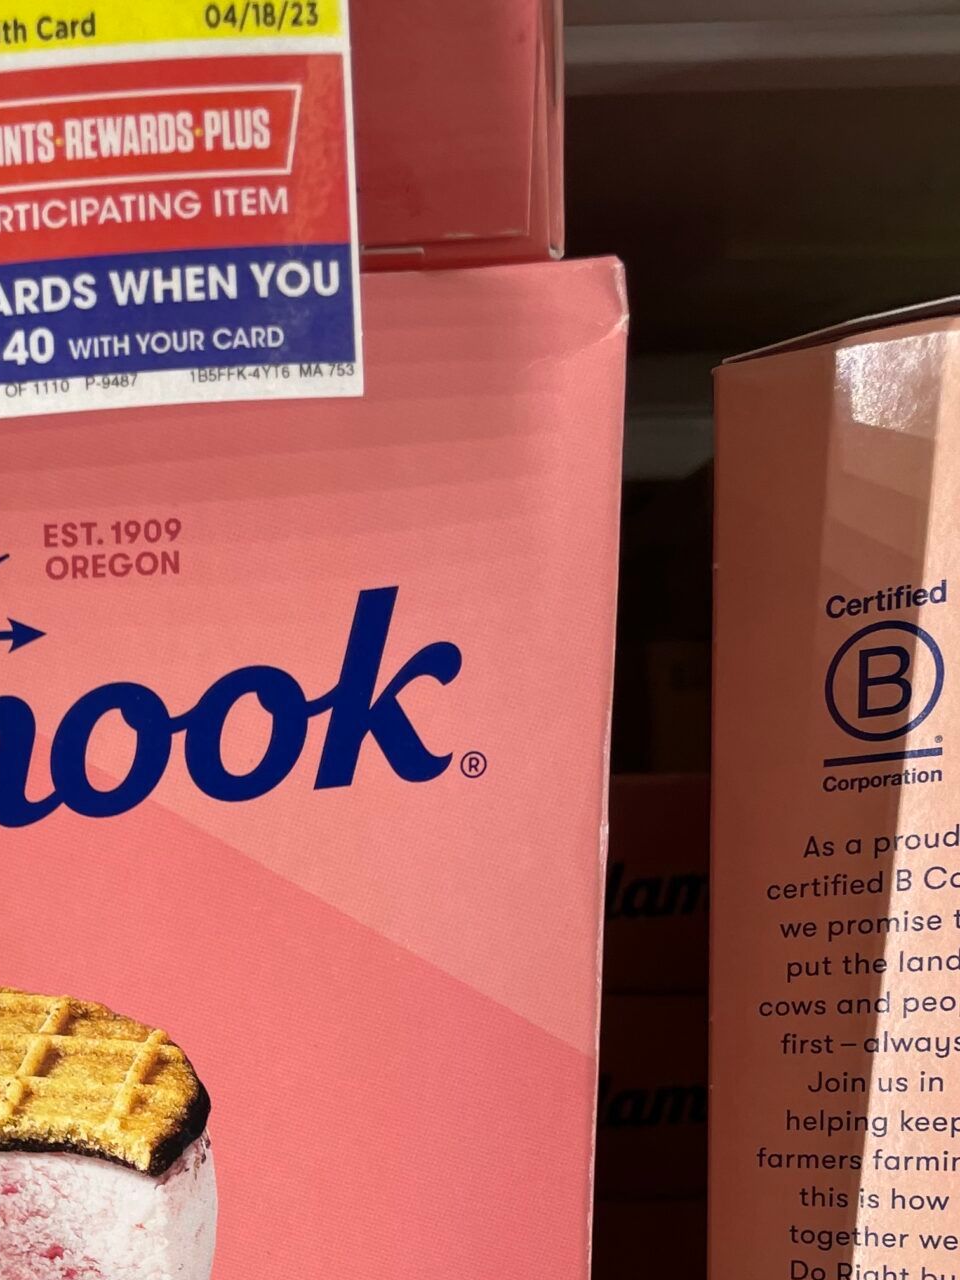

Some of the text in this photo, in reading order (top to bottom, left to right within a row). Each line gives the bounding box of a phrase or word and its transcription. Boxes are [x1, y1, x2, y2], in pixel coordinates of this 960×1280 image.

[36, 14, 97, 40] Card
[204, 1, 320, 30] 04/18/23
[213, 186, 289, 218] ITEM
[108, 262, 239, 307] WHEN
[250, 260, 341, 299] YOU
[68, 333, 130, 362] WITH
[136, 329, 205, 356] YOUR
[212, 325, 285, 351] CARD
[4, 383, 27, 398] OF
[34, 379, 71, 395] 1110
[84, 373, 139, 391] P-9487
[299, 363, 355, 378] MA 753
[43, 517, 182, 548] EST. 1909
[45, 550, 181, 581] OREGON
[825, 579, 948, 619] Certified
[822, 767, 943, 793] Corporation
[803, 824, 960, 859] As a proud
[767, 868, 913, 901] certified B
[780, 920, 817, 938] we
[828, 910, 942, 942] promise
[787, 949, 960, 983] put the land
[759, 991, 890, 1017] cows and
[807, 1070, 944, 1093] Join us in
[786, 1110, 960, 1138] helping keep
[756, 1147, 862, 1170] farmers
[799, 1186, 950, 1211] this is how
[789, 1224, 958, 1251] together we
[790, 1260, 826, 1280] Do
